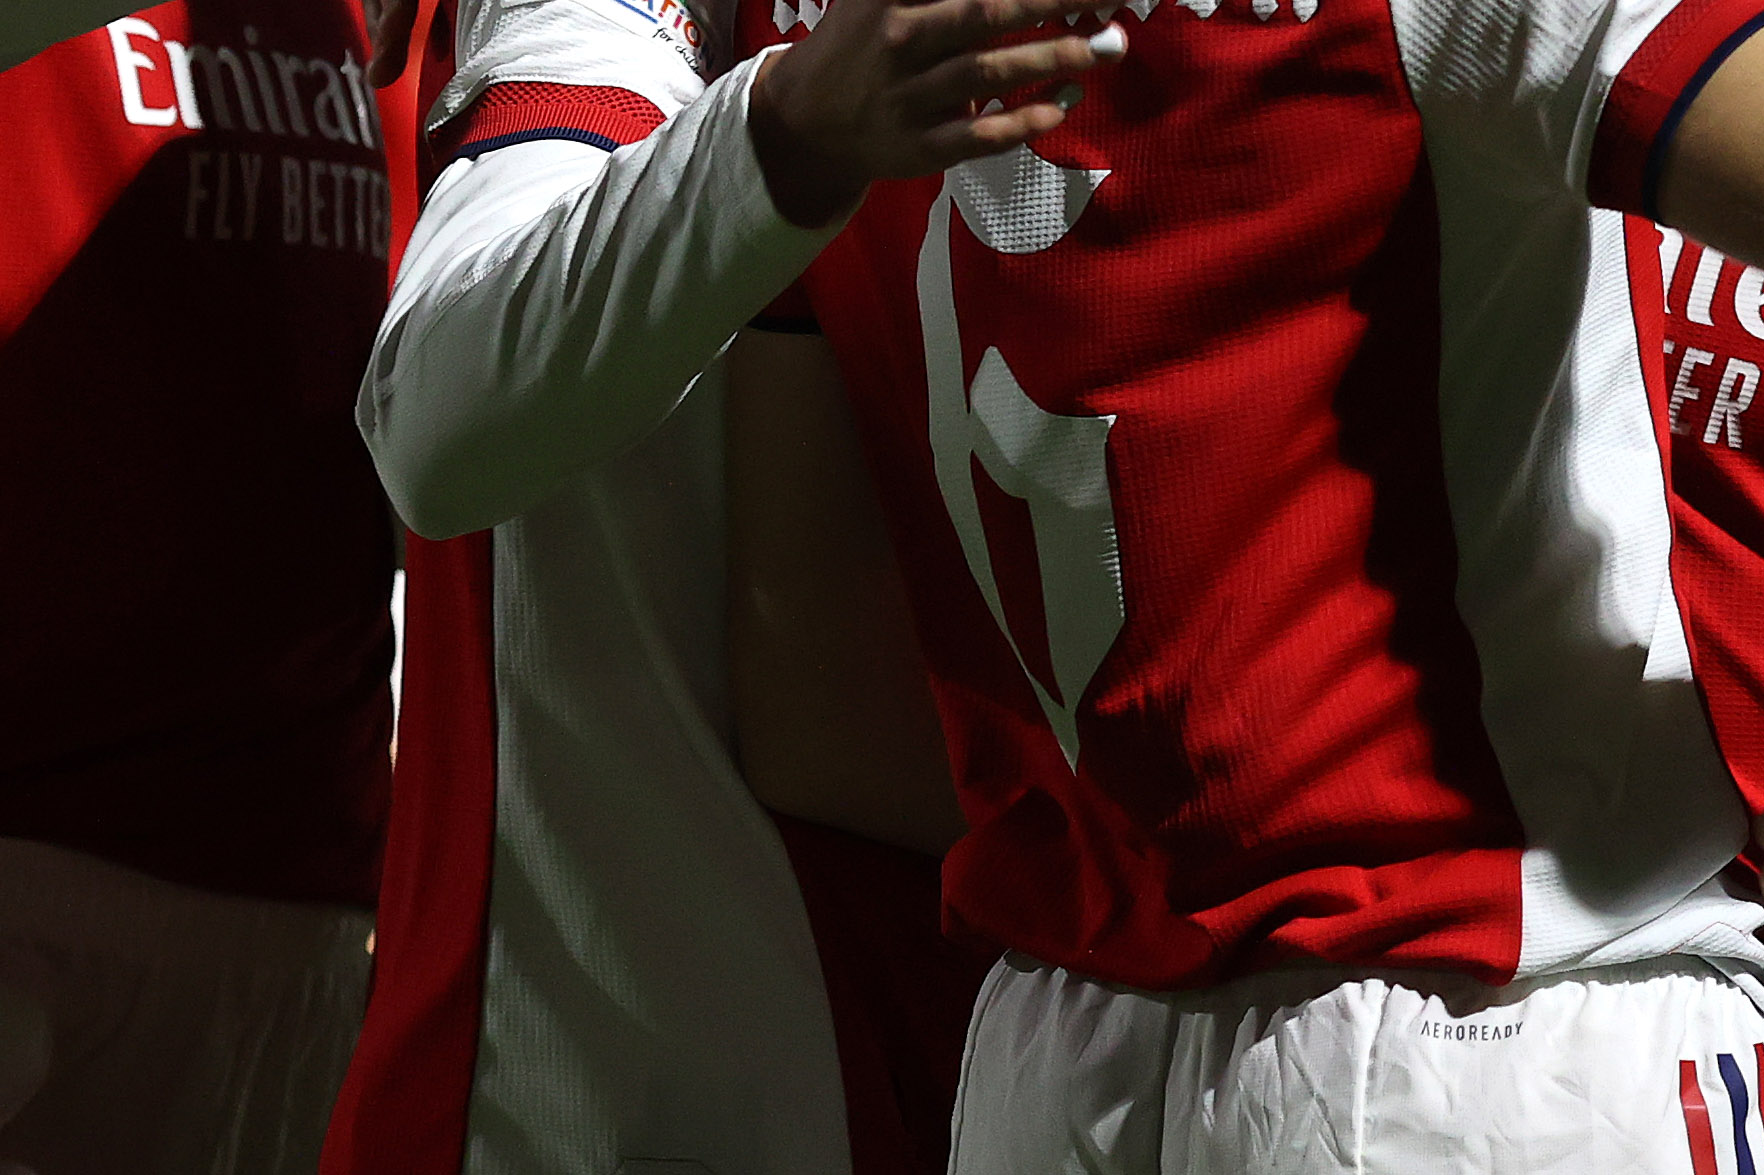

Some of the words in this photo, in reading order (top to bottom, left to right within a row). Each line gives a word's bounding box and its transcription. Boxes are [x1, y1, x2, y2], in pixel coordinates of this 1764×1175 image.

[652, 27, 674, 43] for
[106, 16, 383, 151] Emirat
[184, 149, 263, 242] FLY
[1420, 1020, 1524, 1041] AEROREADY
